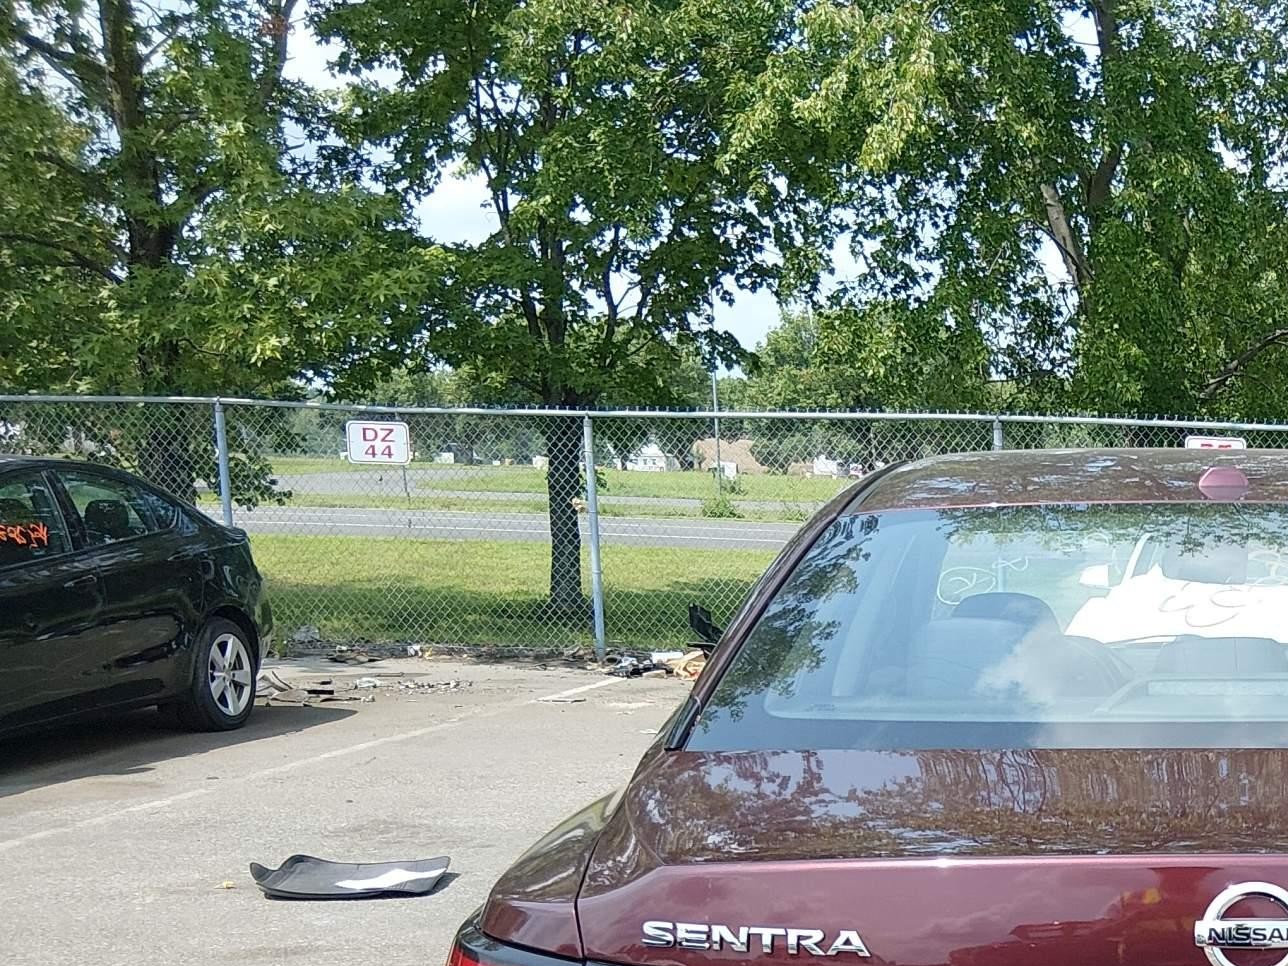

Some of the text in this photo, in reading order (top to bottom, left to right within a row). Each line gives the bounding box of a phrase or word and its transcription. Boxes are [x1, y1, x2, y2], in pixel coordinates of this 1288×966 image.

[362, 427, 395, 442] DZ
[364, 444, 394, 459] 44
[641, 920, 872, 958] SENTRA
